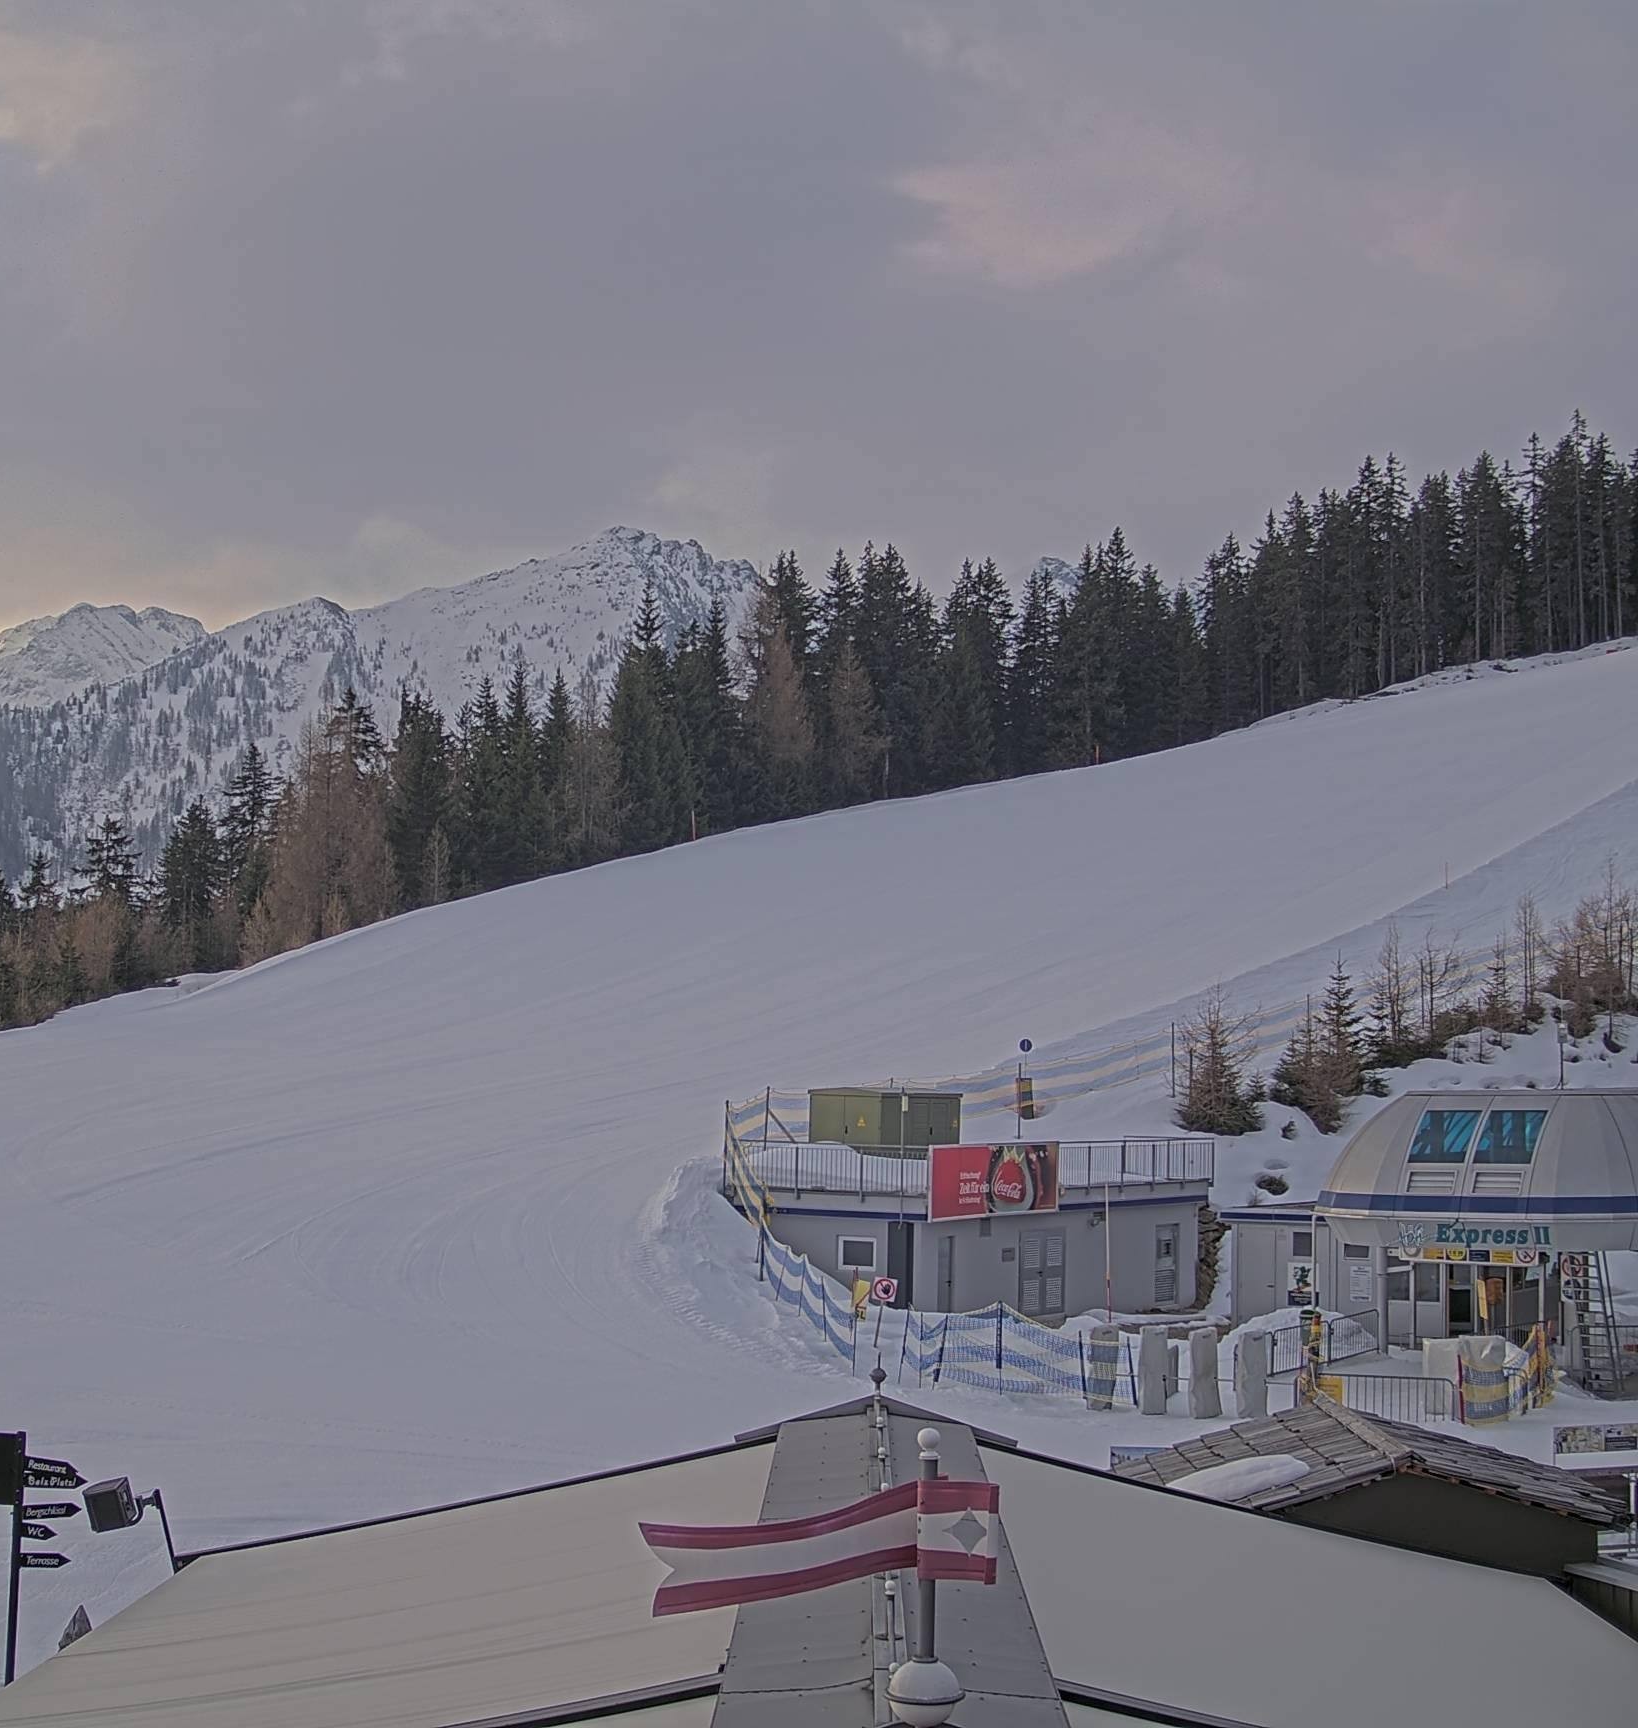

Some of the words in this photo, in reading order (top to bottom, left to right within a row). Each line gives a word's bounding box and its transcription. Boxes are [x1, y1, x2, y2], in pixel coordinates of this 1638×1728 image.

[1436, 1223, 1529, 1248] Express
[1533, 1226, 1551, 1245] II
[28, 1460, 67, 1474] Restaurant
[27, 1526, 45, 1537] WC
[26, 1555, 60, 1566] Terrasse
